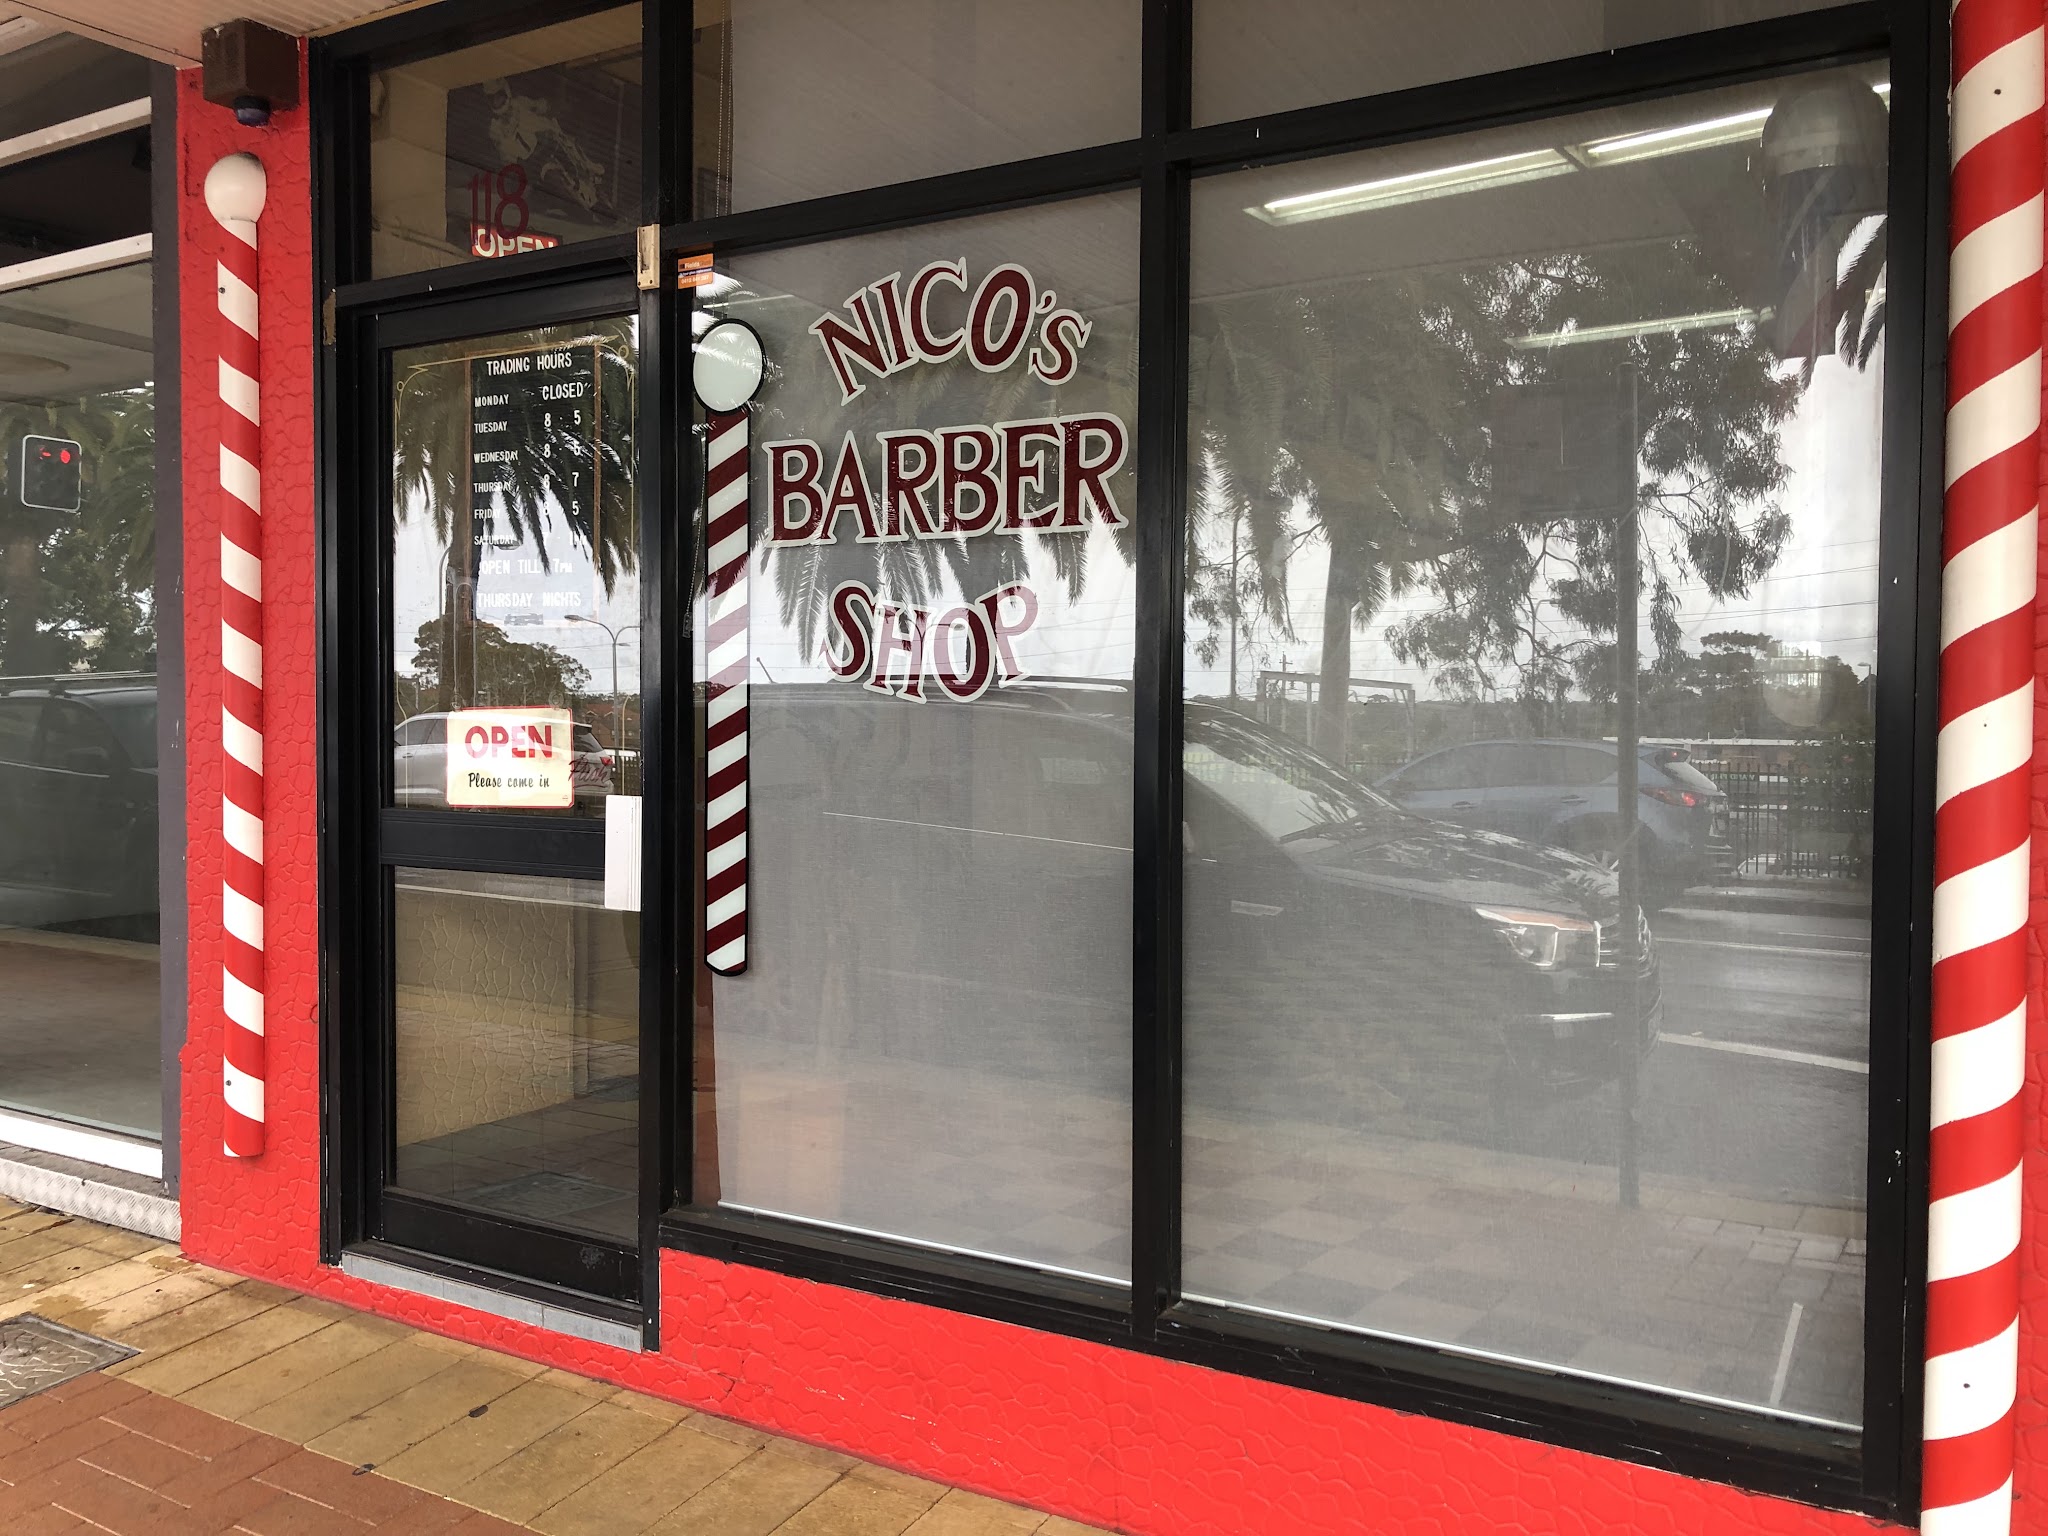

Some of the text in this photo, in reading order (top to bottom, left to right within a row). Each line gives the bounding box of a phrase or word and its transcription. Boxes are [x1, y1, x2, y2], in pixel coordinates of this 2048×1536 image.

[468, 163, 530, 246] 118
[486, 352, 573, 376] TRADING HOURS
[474, 394, 510, 408] MONDAY
[474, 409, 582, 434] TUESDAY 8 5
[473, 450, 519, 464] WEDNESDAY
[543, 443, 551, 459] 8
[473, 471, 579, 493] THURSDAY 8 7
[761, 411, 1130, 547] BARBER
[474, 500, 580, 520] FRIDAY 8 5
[474, 534, 515, 546] SATURDAY
[480, 557, 573, 575] OPEN TILL 7PM
[477, 591, 582, 608] THURSDAY NIGHTS
[821, 579, 1040, 704] SHOP
[465, 725, 553, 758] OPEN
[468, 772, 550, 788] Please come in
